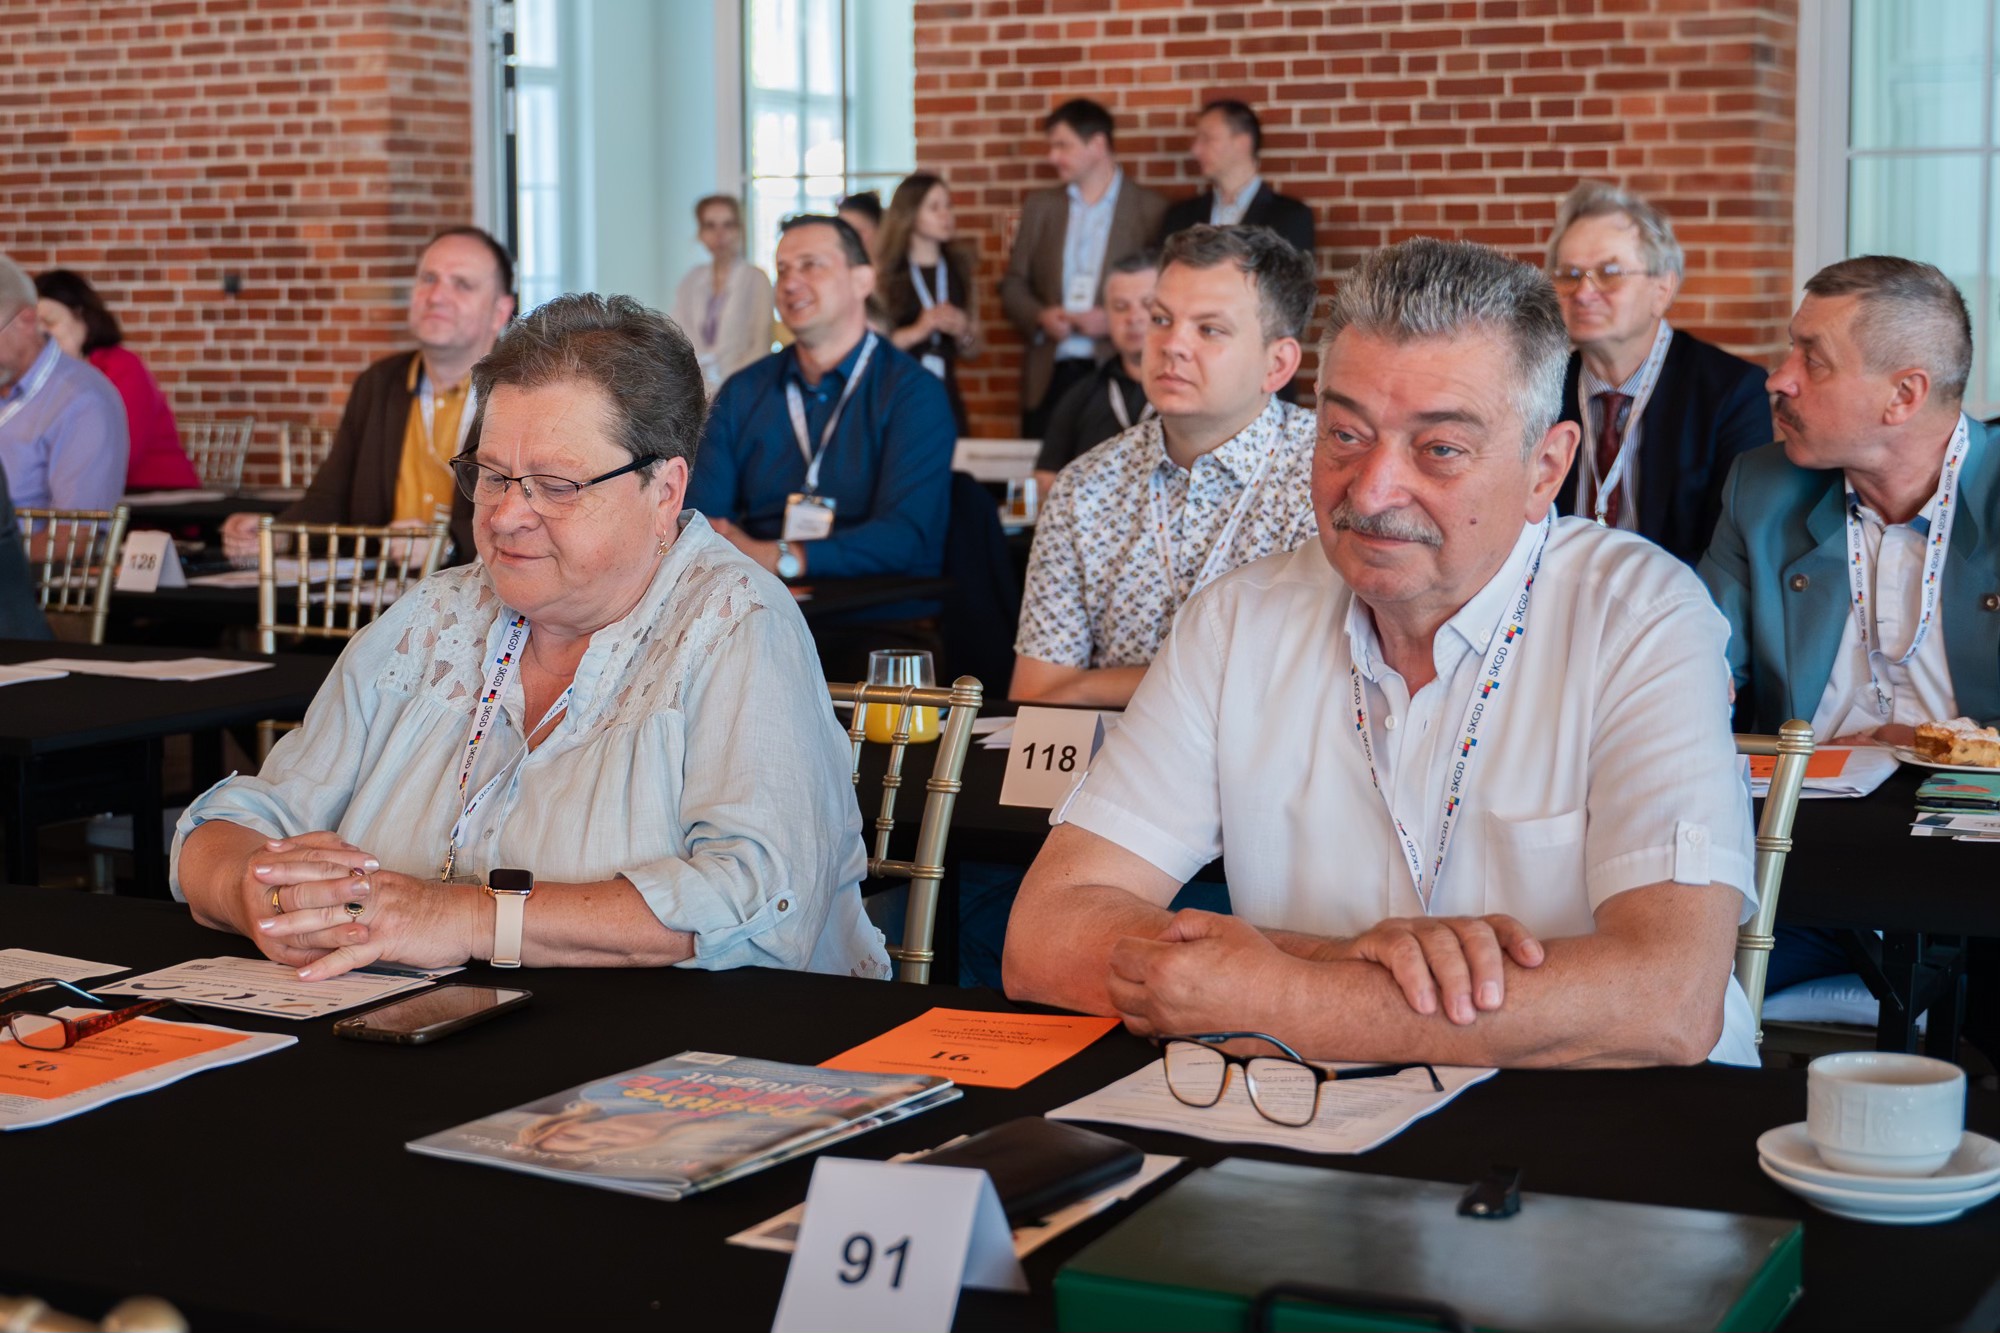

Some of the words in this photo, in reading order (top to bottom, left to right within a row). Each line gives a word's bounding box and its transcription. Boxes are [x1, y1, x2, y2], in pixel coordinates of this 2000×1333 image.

[1512, 593, 1530, 622] SKGD
[507, 629, 522, 651] SKGD
[492, 666, 508, 687] SKGD
[1489, 647, 1508, 677] SKGD
[1353, 675, 1361, 705] SKGD
[478, 705, 493, 728] SKGD
[1467, 703, 1484, 734] SKGD
[464, 746, 478, 769] SKGD
[1022, 742, 1077, 772] 118
[1361, 730, 1372, 761] SKGD
[1450, 761, 1465, 793] SKGD
[1439, 821, 1449, 852] SKGD
[1406, 840, 1419, 870] SKGD
[930, 1051, 970, 1061] 91
[838, 1234, 910, 1288] 91
